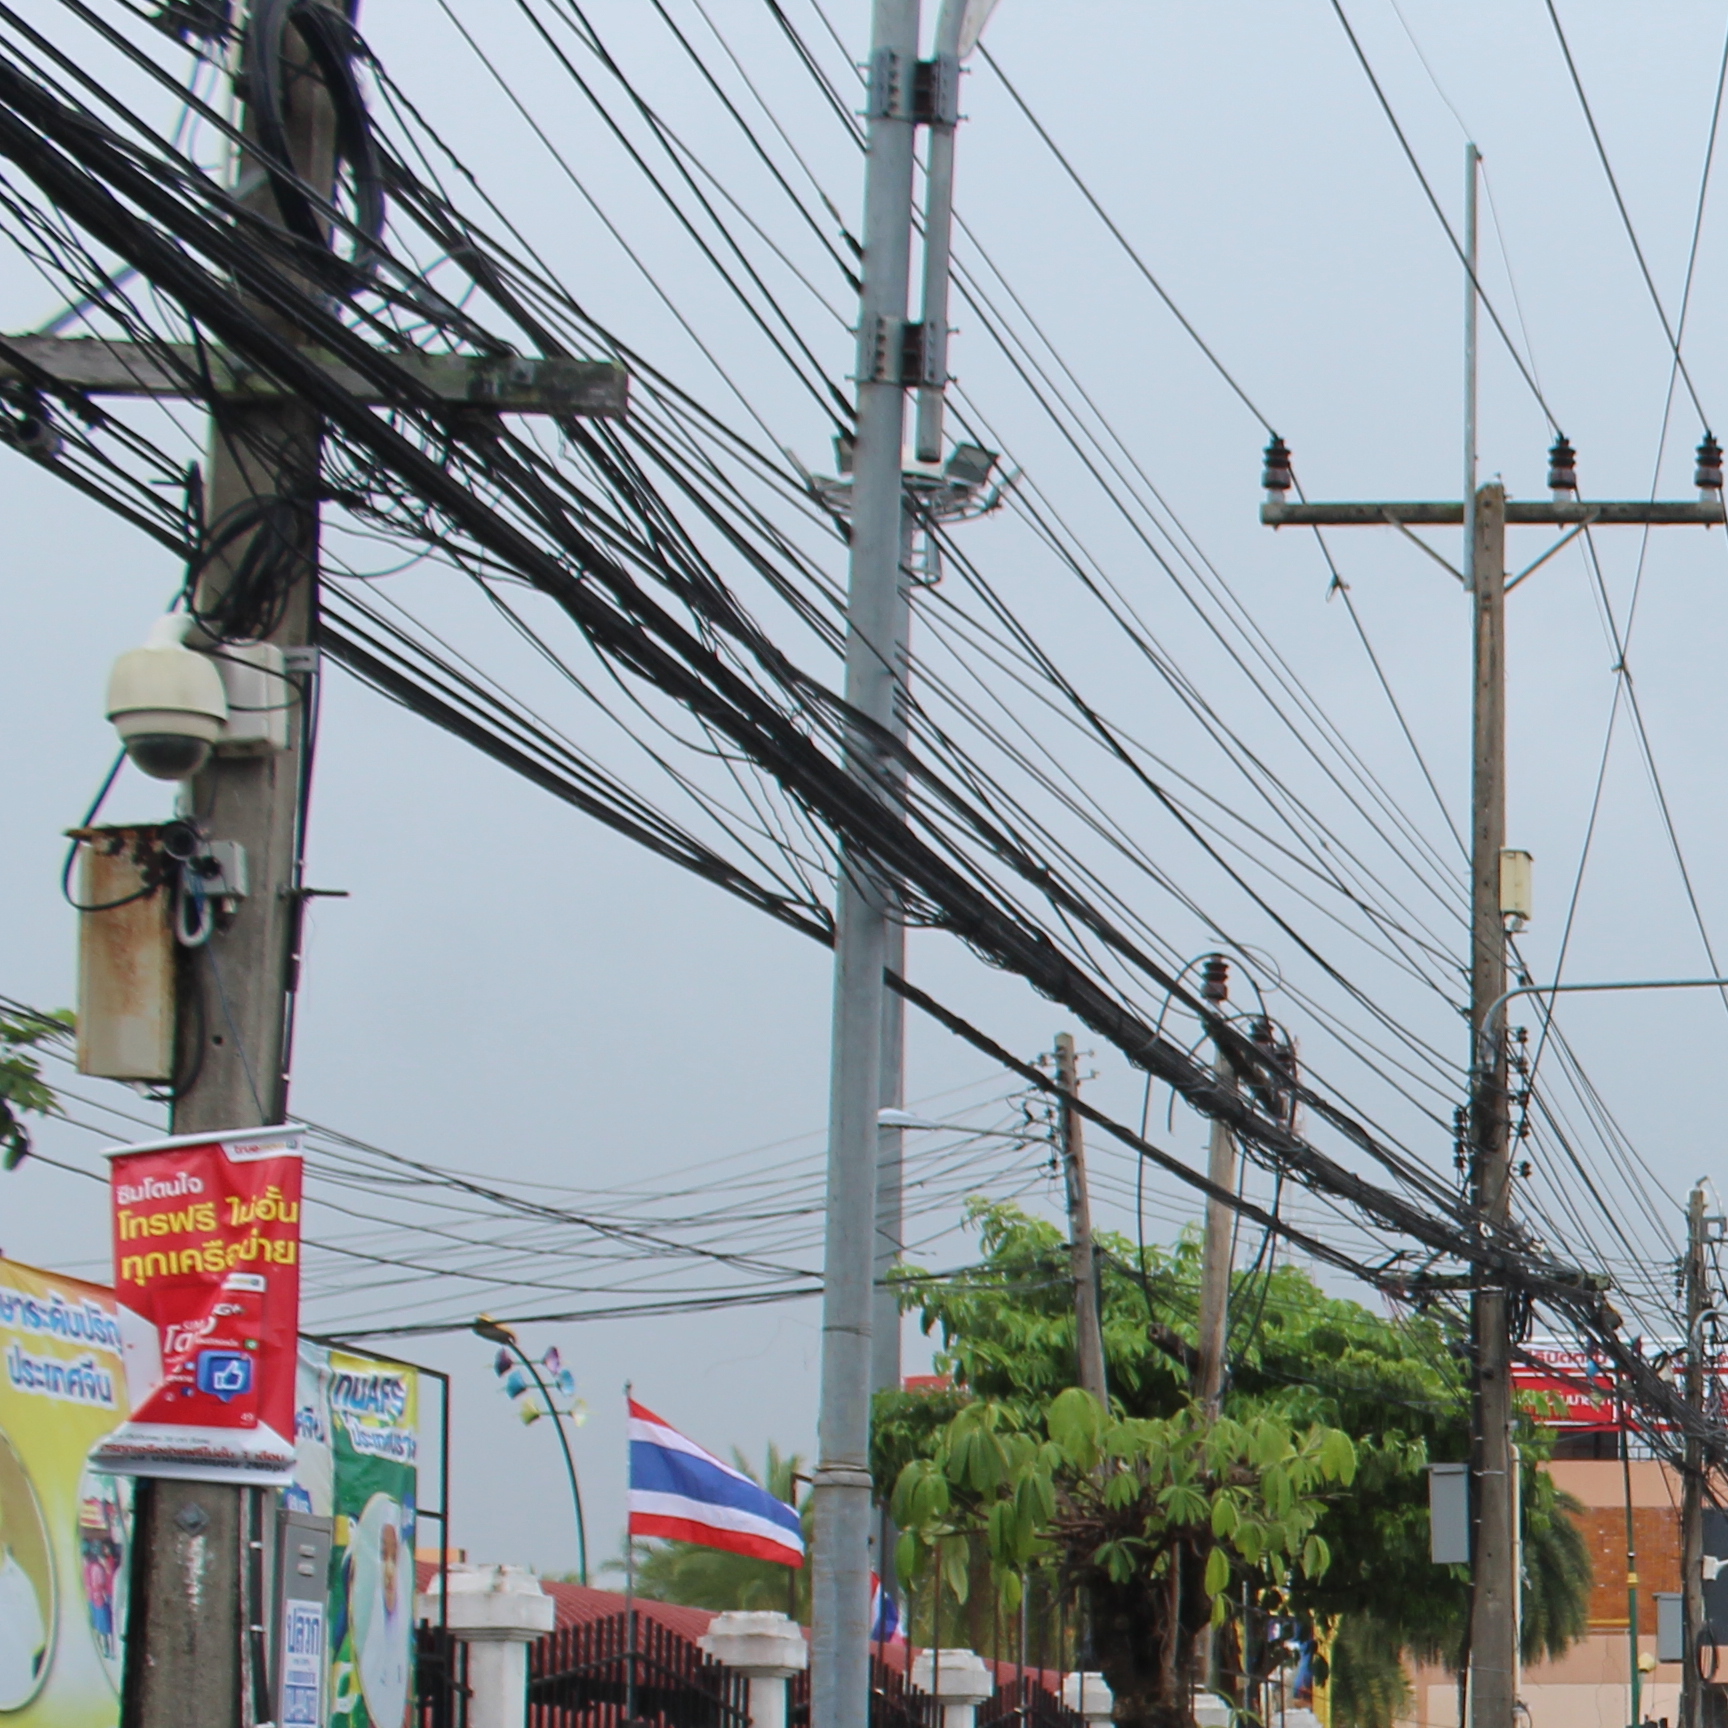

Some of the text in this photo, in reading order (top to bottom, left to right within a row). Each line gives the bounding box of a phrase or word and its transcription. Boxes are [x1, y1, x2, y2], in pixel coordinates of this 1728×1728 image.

[117, 1172, 204, 1205] ซิมโดนใจ
[118, 1185, 299, 1241] โทรฟรี ไม่อั้น
[121, 1228, 297, 1287] ทุกเครือข่าย
[8, 1345, 112, 1403] ประเทศจีน
